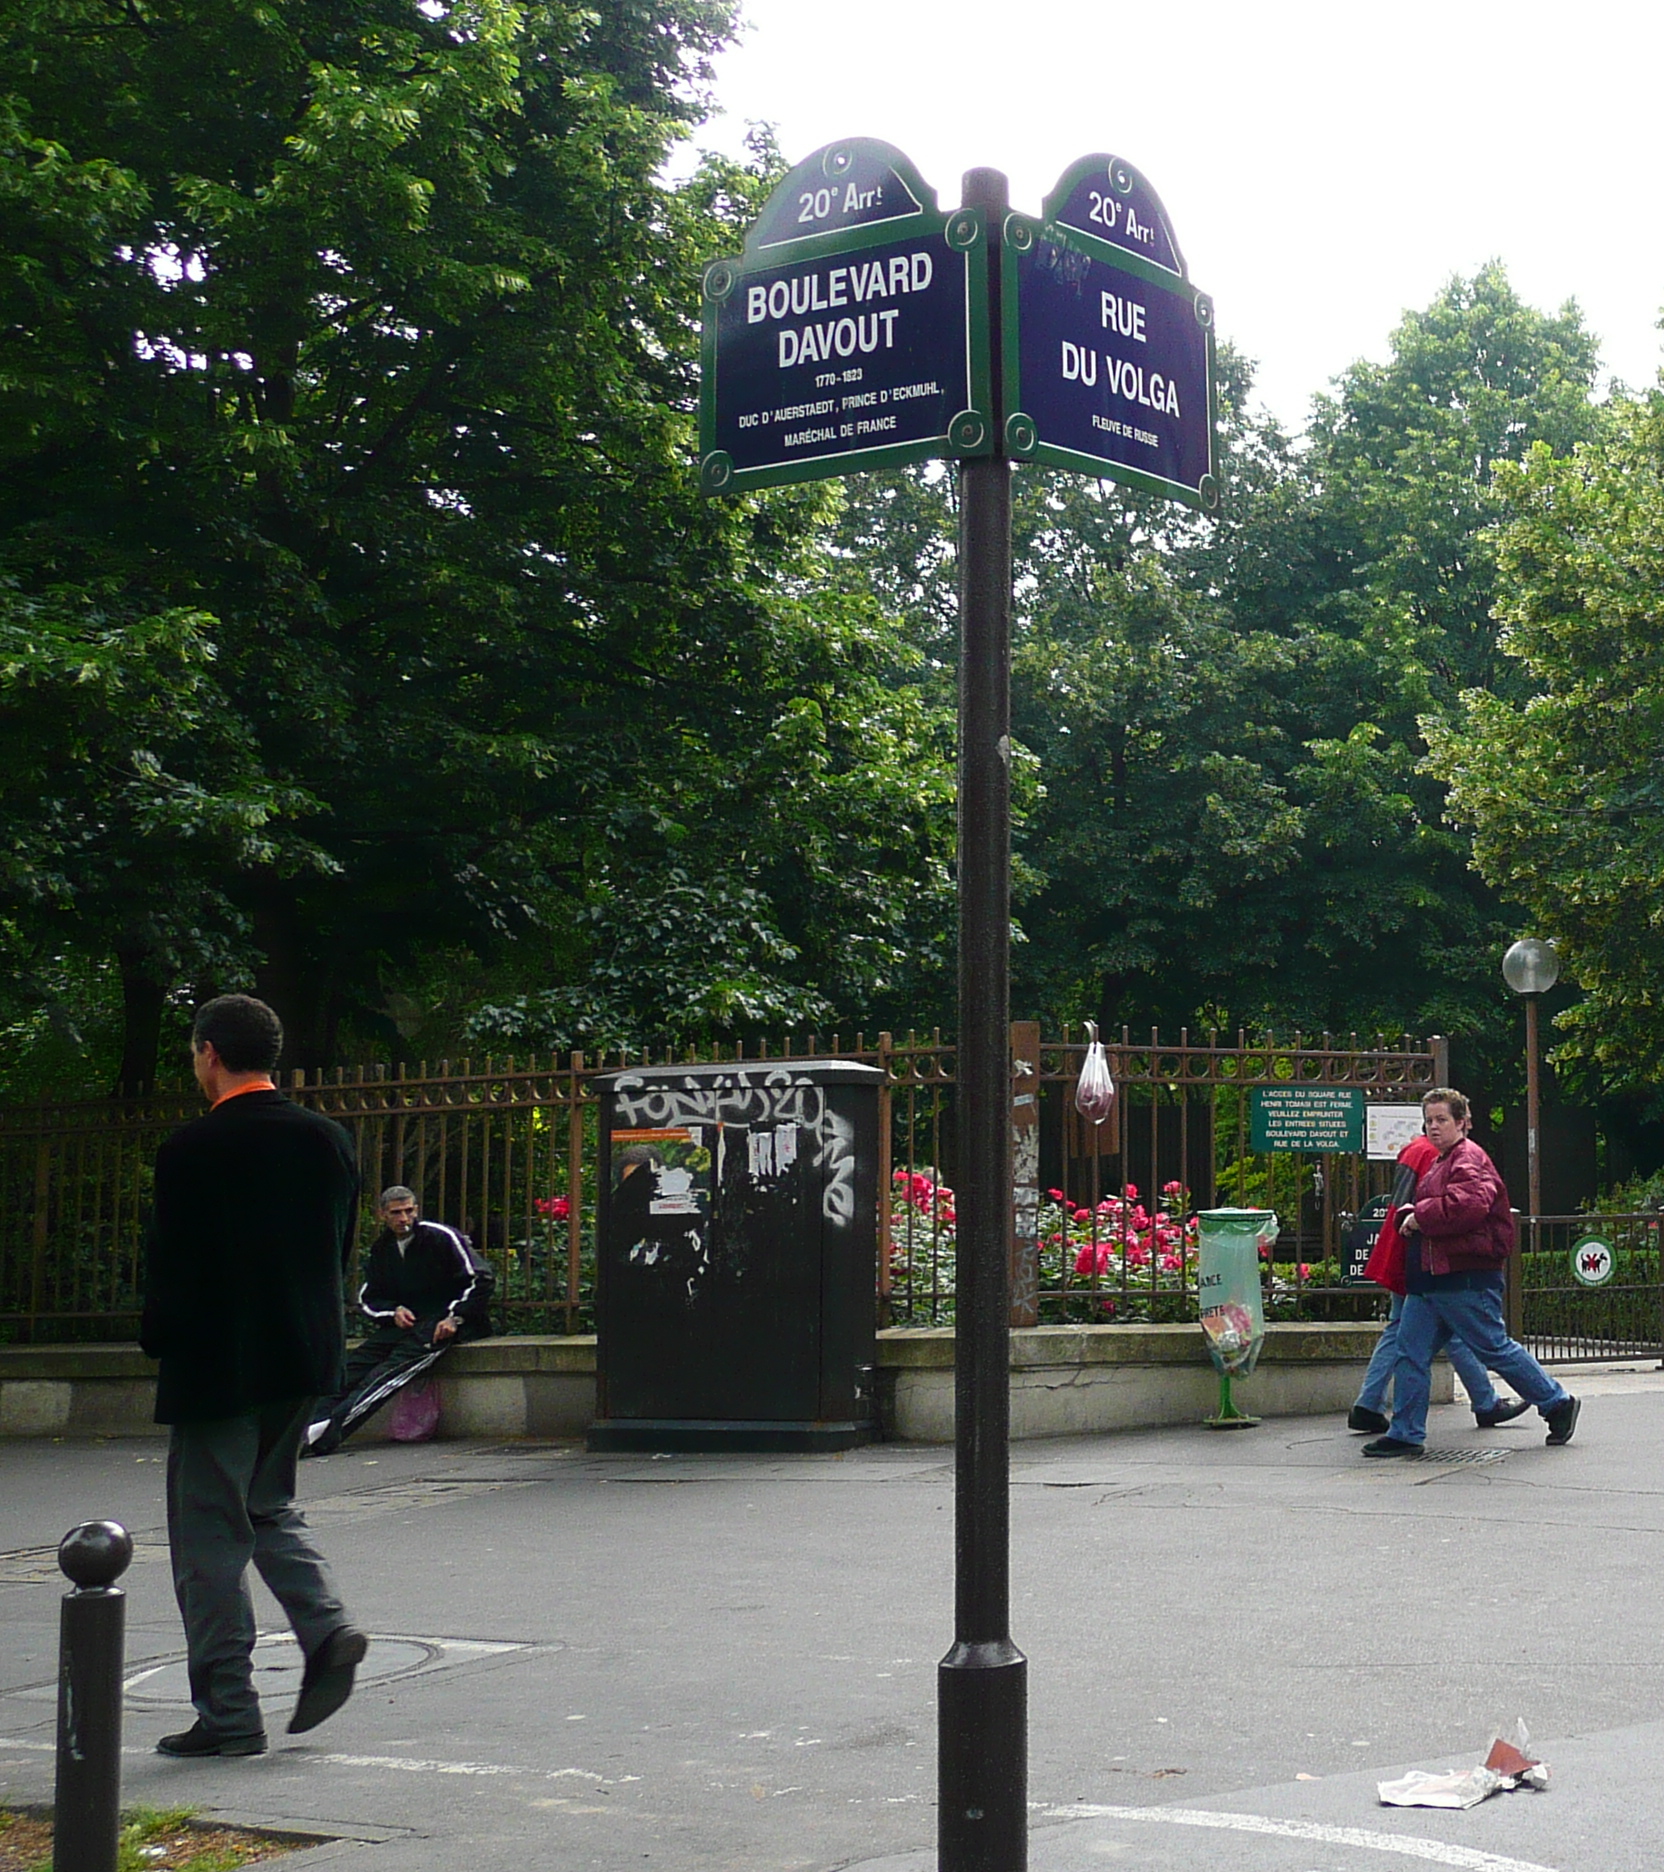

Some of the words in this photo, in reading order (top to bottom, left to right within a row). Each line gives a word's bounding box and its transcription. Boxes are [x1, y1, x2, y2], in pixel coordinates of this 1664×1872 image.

[748, 252, 933, 324] BOULEVARD
[1101, 290, 1146, 343] RUE
[779, 309, 899, 368] DAVOUT
[1062, 341, 1096, 386] DU
[1106, 355, 1180, 419] VOLGA
[739, 413, 759, 428] DUC
[842, 392, 877, 410] PRINCE
[784, 426, 837, 447] MARÉCHAL
[840, 423, 854, 437] DE
[857, 416, 897, 435] FRANCE
[1092, 414, 1121, 435] FLEUVE
[1123, 424, 1133, 439] DE
[1134, 428, 1159, 448] RUSSIE
[1295, 1090, 1305, 1098] DU
[1308, 1090, 1335, 1098] SQUARE
[1338, 1091, 1352, 1099] RUE
[1261, 1100, 1282, 1108] HENRI
[1268, 1110, 1299, 1118] VEUILLEZ
[1302, 1110, 1344, 1118] EMPRUNTER
[1268, 1120, 1282, 1128] LES
[1265, 1130, 1307, 1138] BOULEVARD
[1309, 1130, 1336, 1138] DAVOUT
[1274, 1140, 1288, 1148] RUE
[1291, 1140, 1301, 1148] DE
[1304, 1140, 1313, 1148] LA
[1355, 1249, 1369, 1260] DE
[1350, 1264, 1364, 1276] DE
